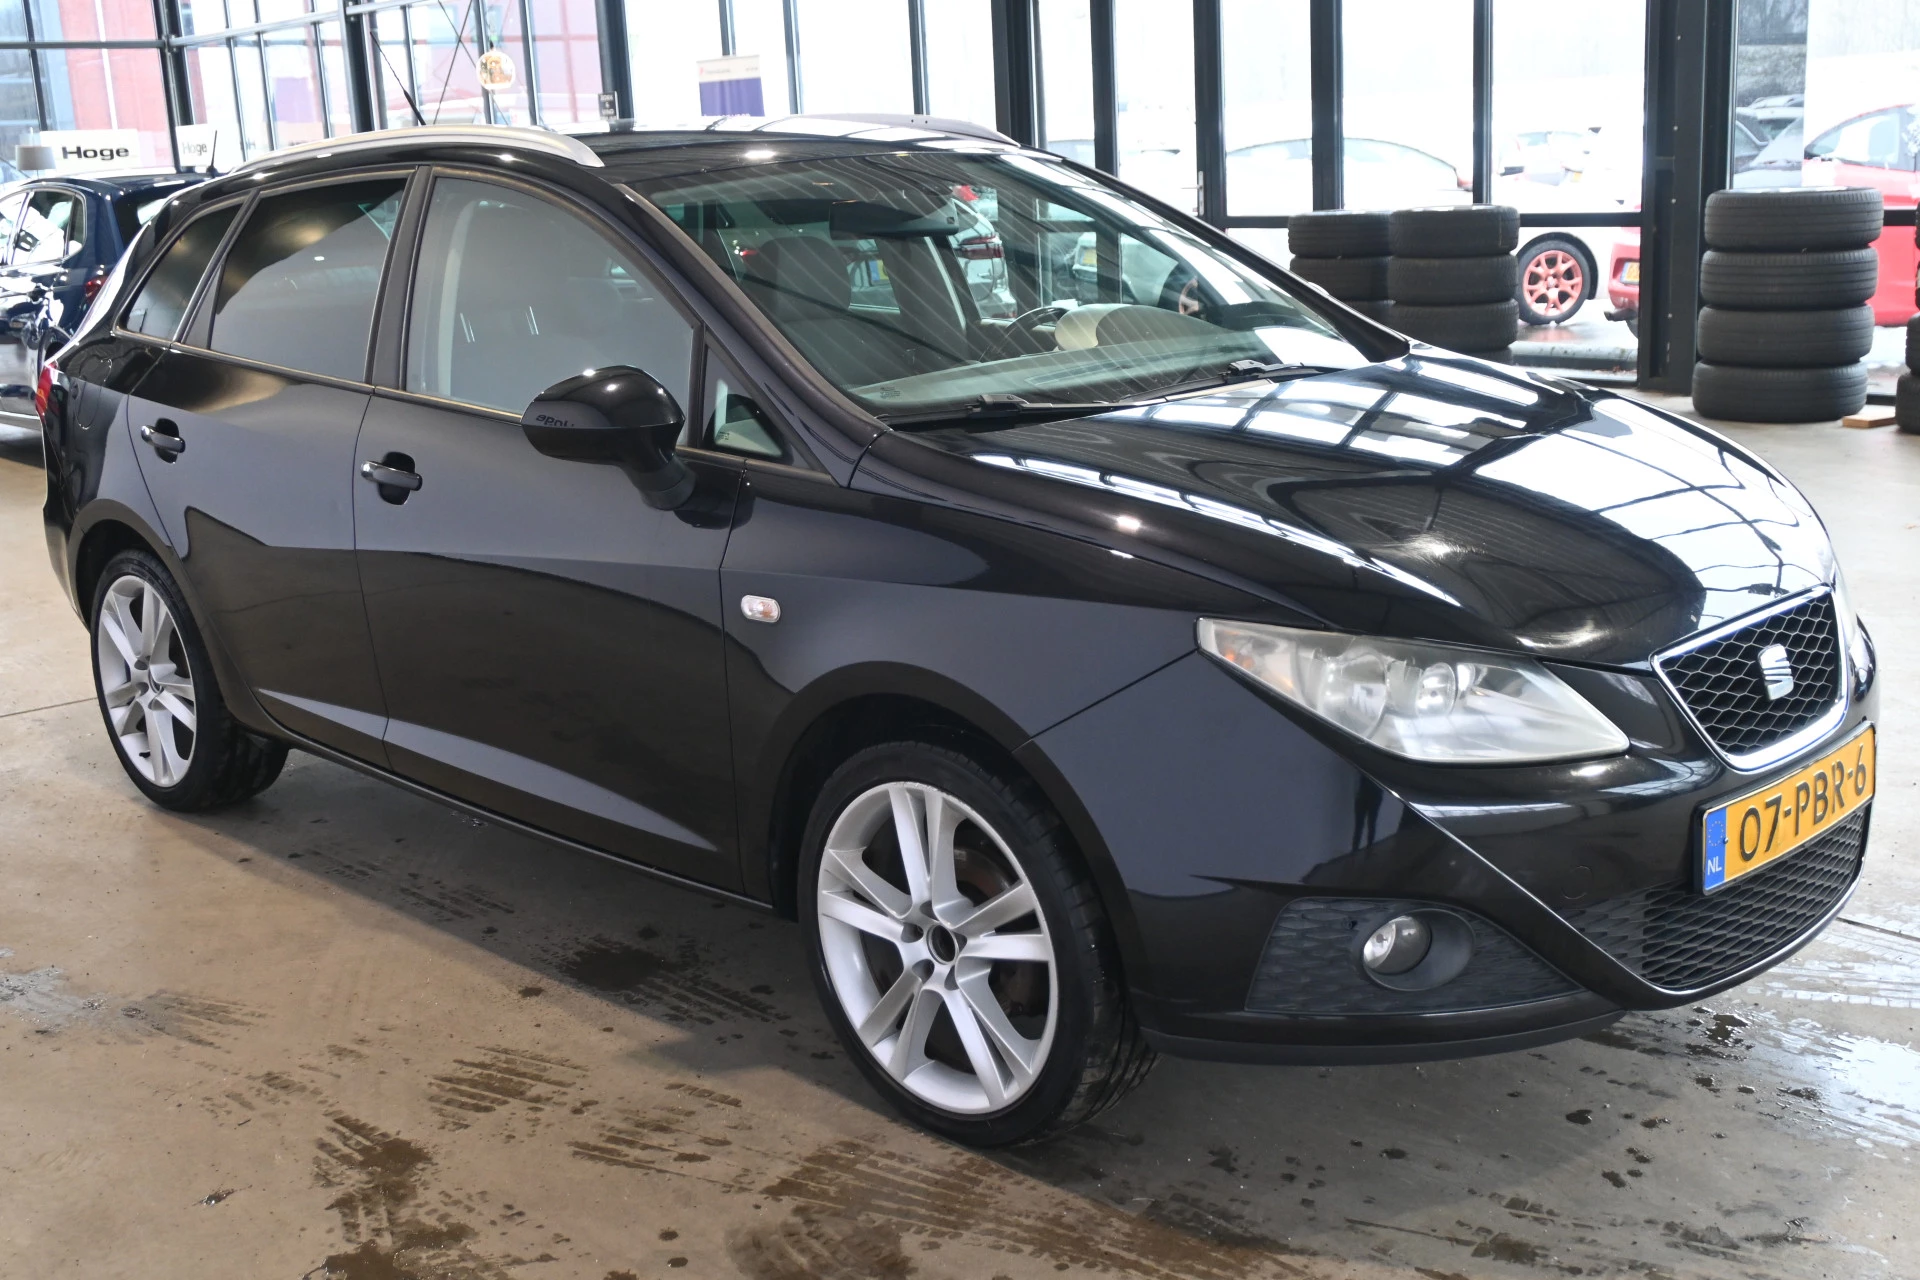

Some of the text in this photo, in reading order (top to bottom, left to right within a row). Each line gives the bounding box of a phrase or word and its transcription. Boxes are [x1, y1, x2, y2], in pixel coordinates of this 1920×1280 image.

[61, 145, 130, 161] Hoge
[182, 142, 207, 156] Hoge
[1707, 743, 1867, 875] NL 07-PBR-6
